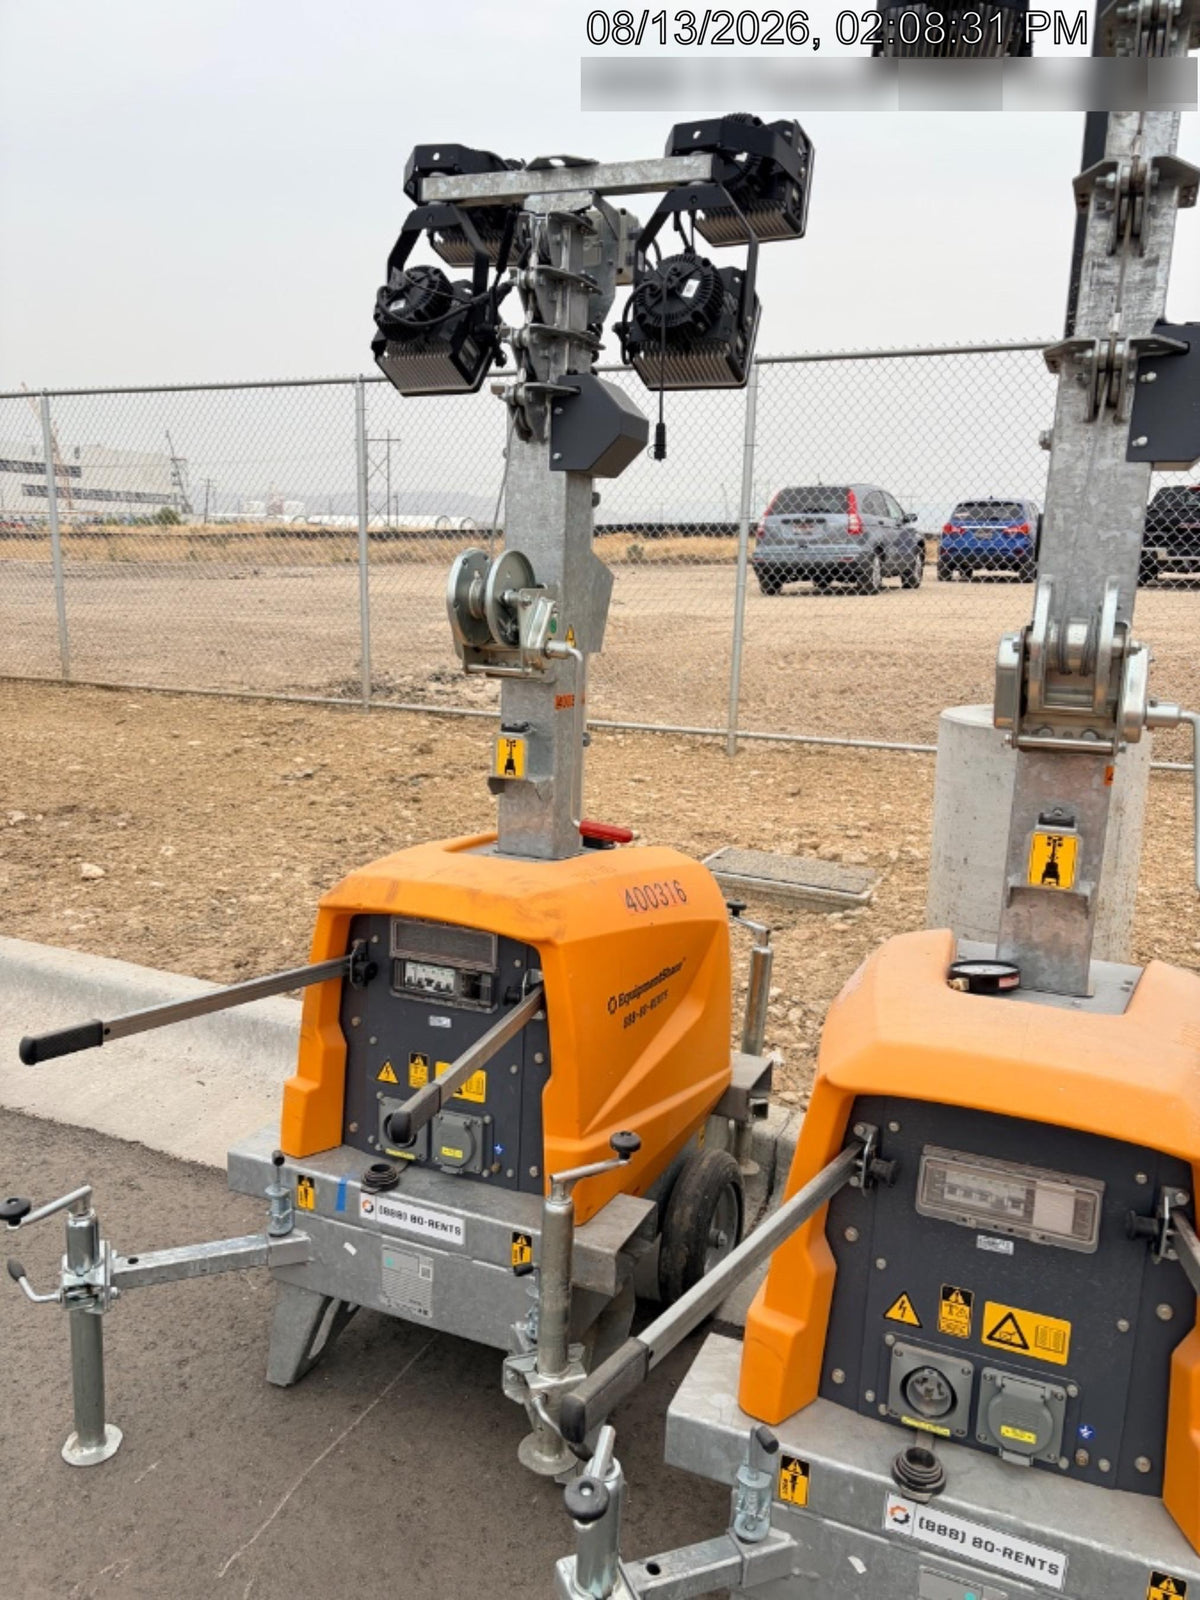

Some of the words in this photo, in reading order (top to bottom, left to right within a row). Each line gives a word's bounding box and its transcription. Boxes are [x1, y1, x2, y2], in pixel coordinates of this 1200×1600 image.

[625, 879, 688, 912] 400316
[379, 1204, 408, 1222] (888)
[410, 1214, 462, 1236] 80-RENTS
[918, 1516, 966, 1544] (888)
[972, 1535, 1060, 1576] 80-RENTS
